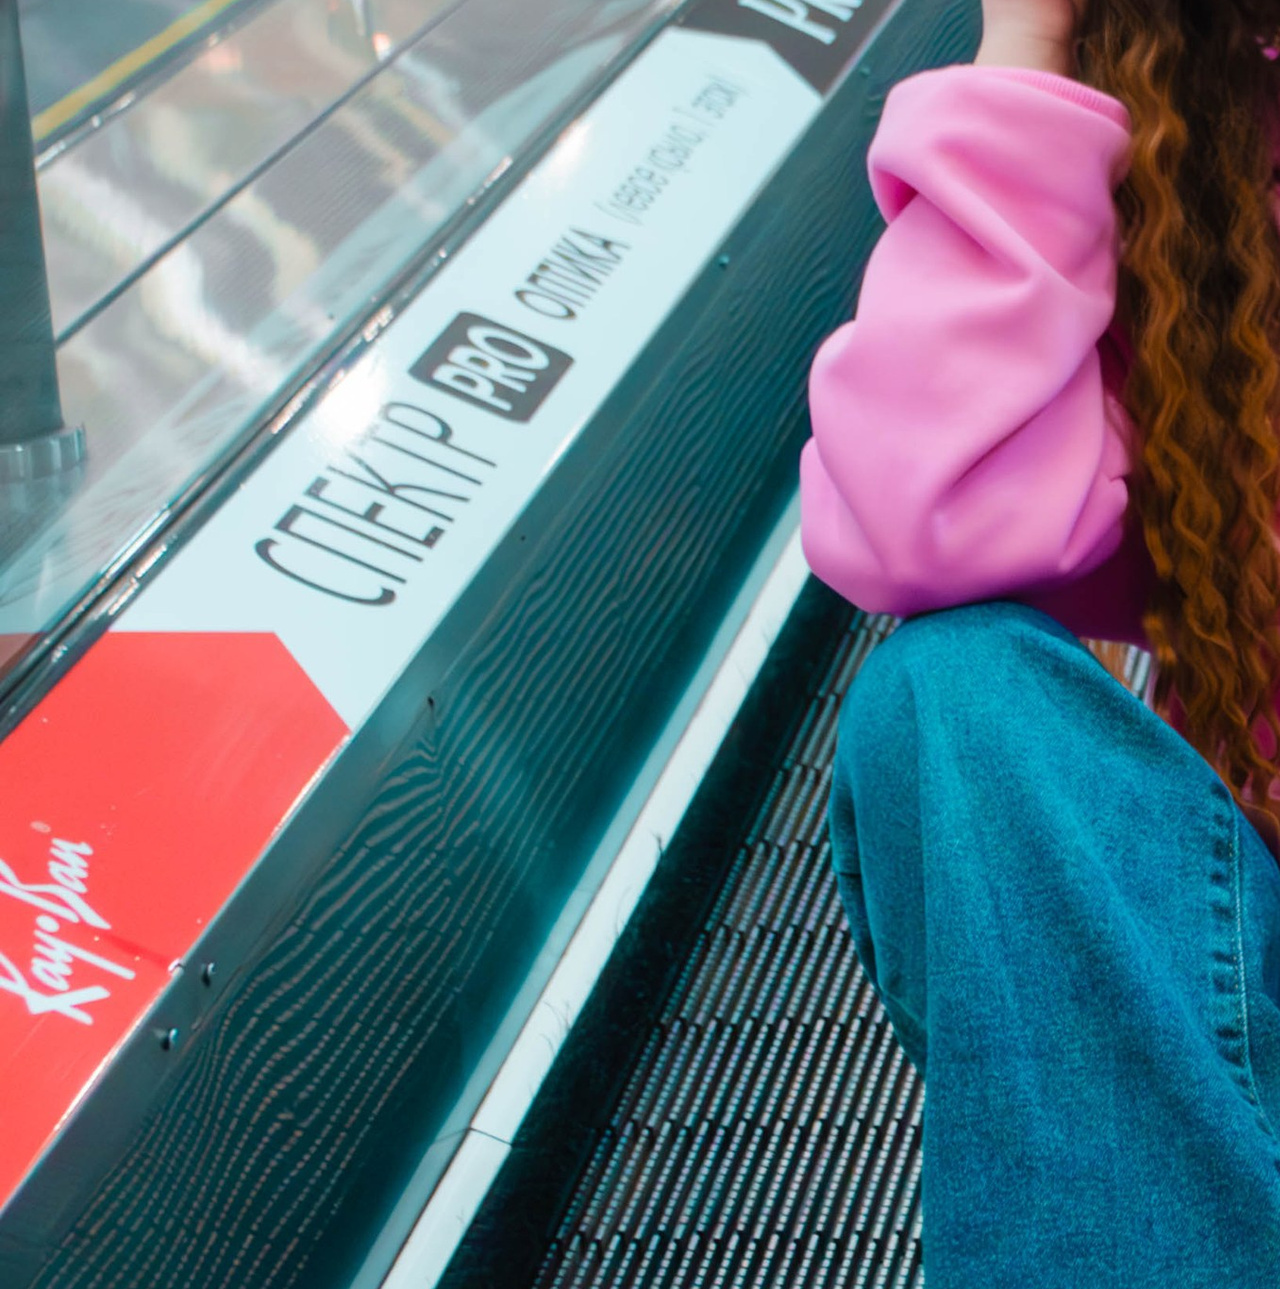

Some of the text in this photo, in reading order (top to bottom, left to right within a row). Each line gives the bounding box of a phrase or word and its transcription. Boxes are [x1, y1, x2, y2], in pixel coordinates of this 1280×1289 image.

[254, 400, 497, 607] СПЕКТР
[431, 324, 551, 412] PRO
[515, 226, 631, 320] ОПТИКА
